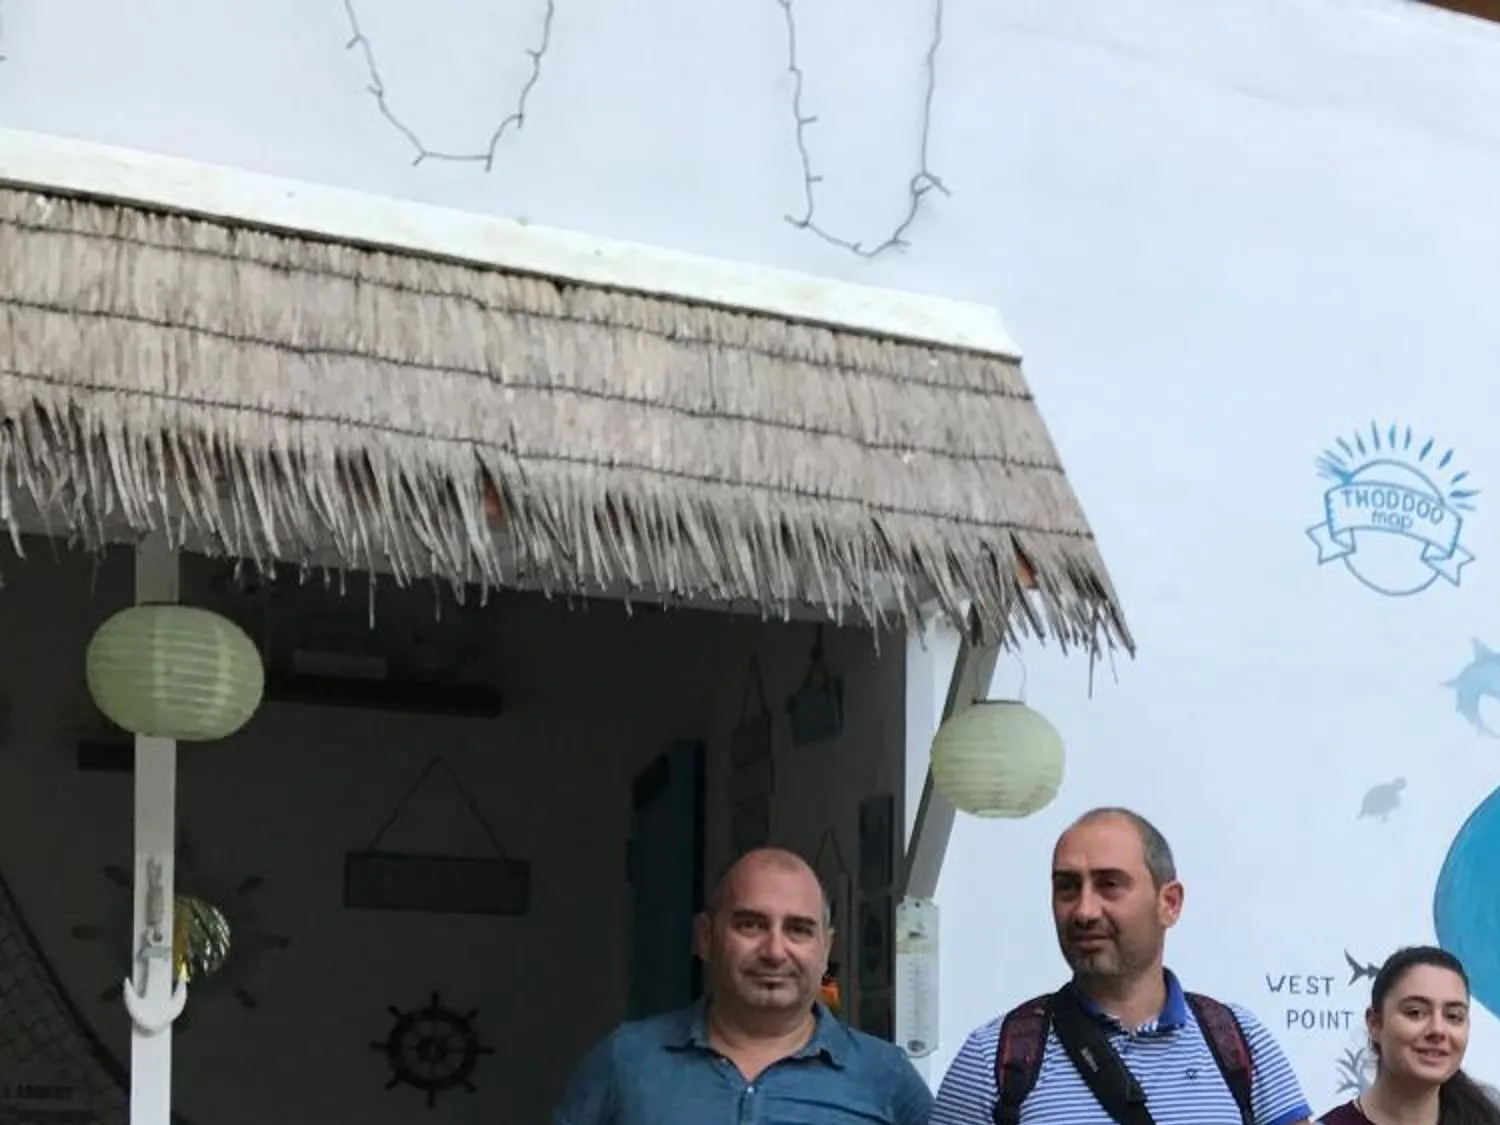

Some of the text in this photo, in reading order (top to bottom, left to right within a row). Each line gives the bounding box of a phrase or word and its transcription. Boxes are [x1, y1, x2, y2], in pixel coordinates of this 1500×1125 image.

[1341, 488, 1444, 525] THODDOO
[1371, 510, 1413, 530] map
[1265, 973, 1335, 997] WEST
[1286, 1008, 1355, 1031] POINT
